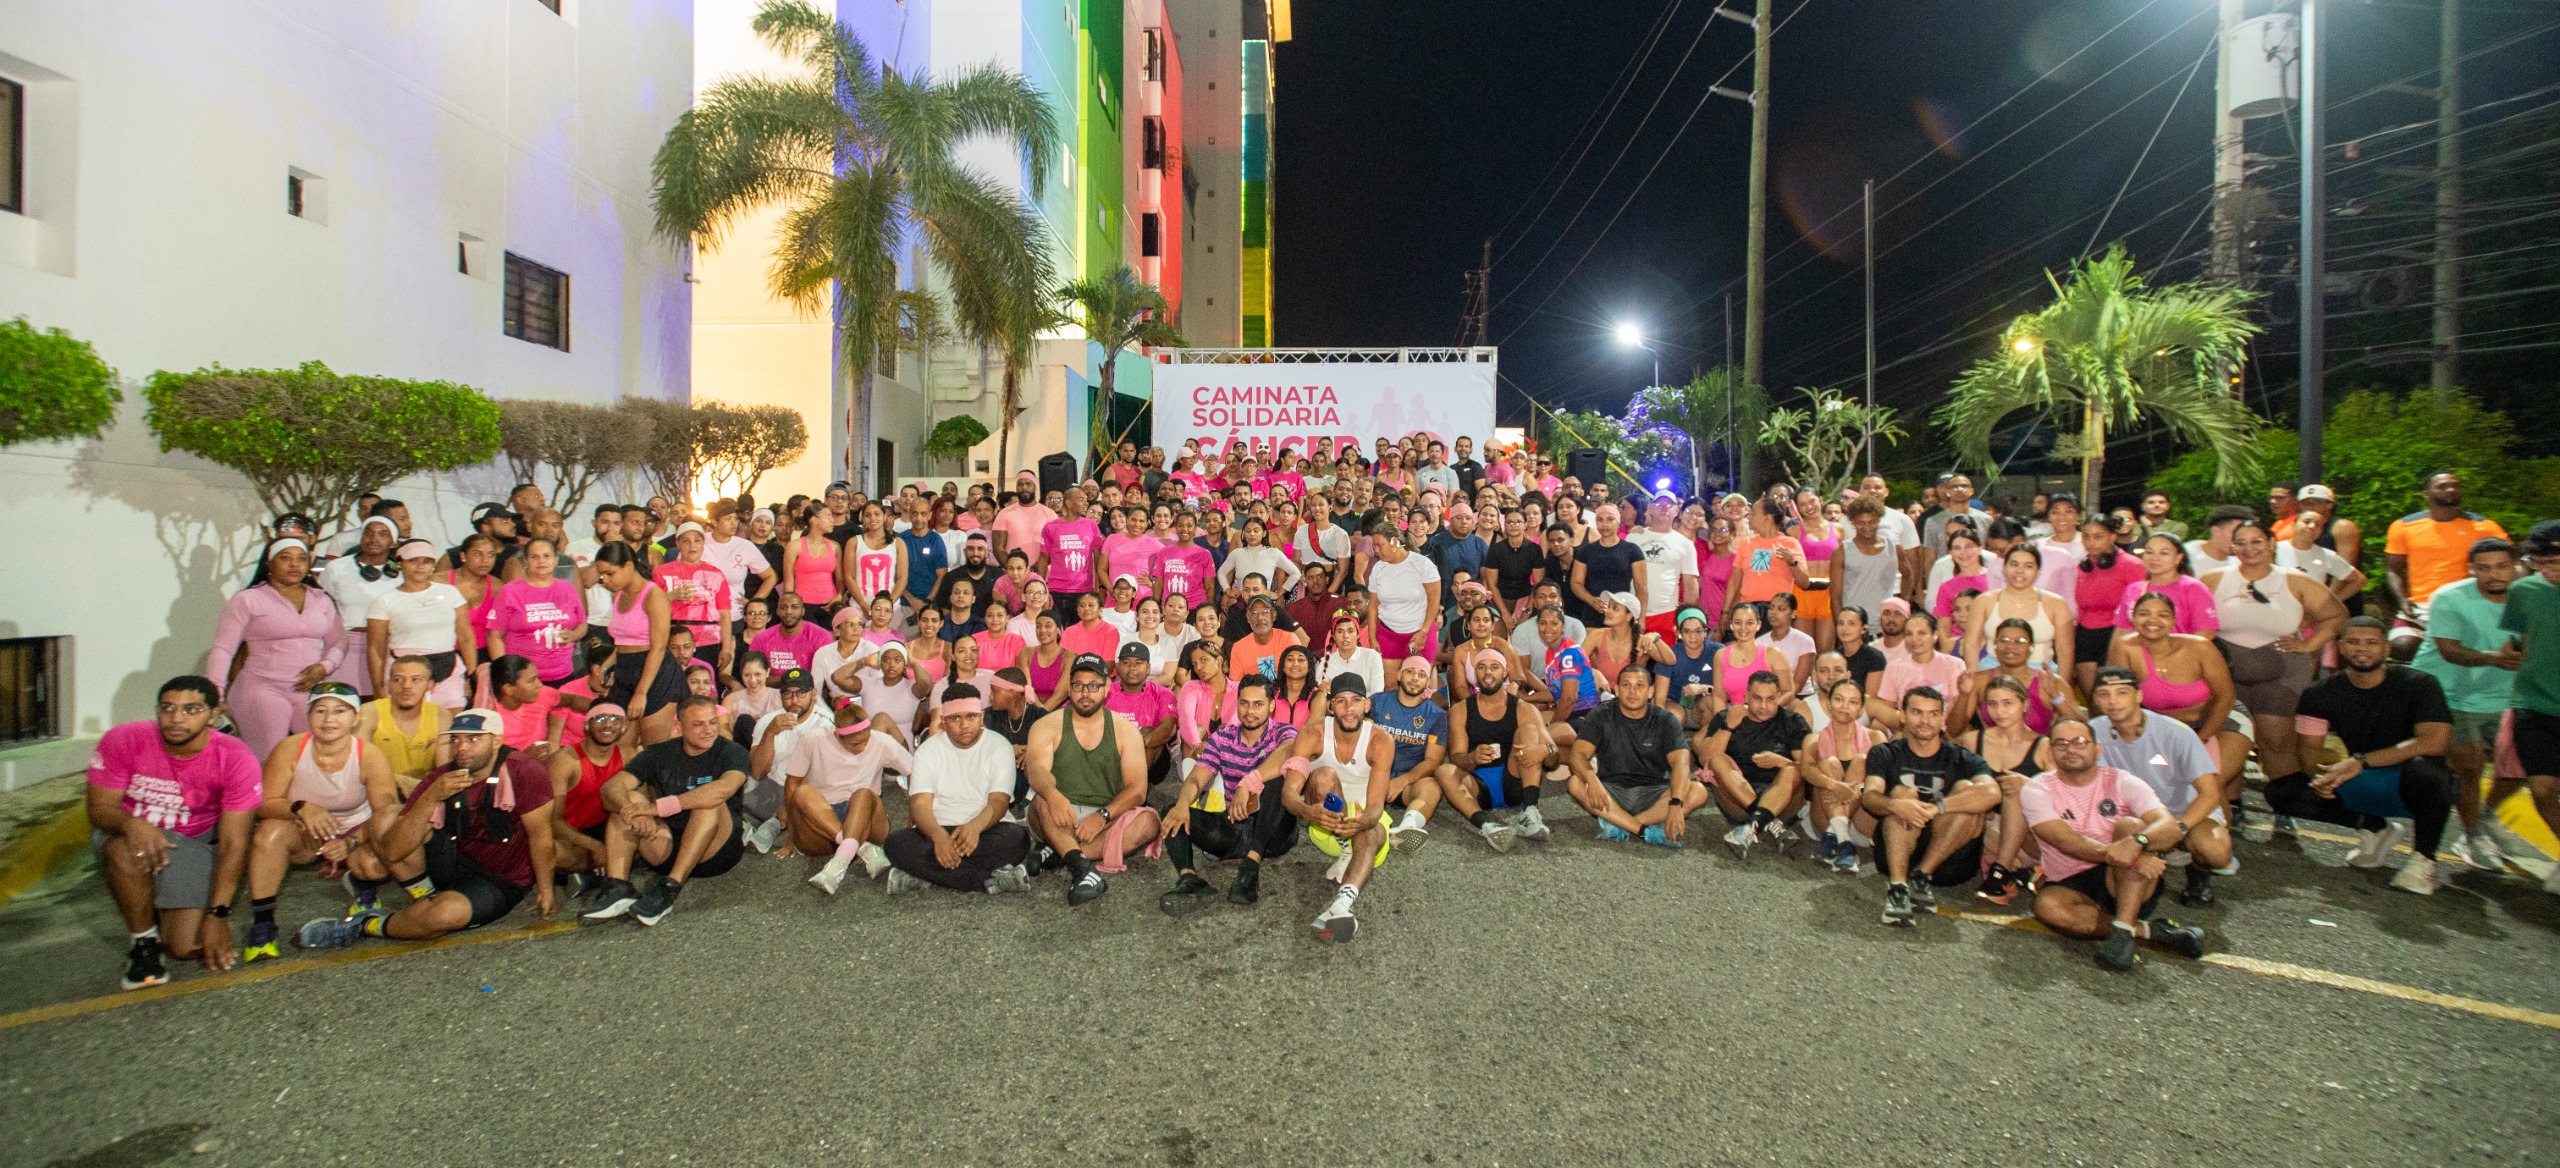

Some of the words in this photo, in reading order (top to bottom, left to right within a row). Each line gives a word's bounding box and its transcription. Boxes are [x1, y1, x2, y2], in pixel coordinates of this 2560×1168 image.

[1193, 386, 1339, 405] CAMINATA
[1192, 407, 1341, 427] SOLIDARIA
[1394, 735, 1426, 746] RITION
